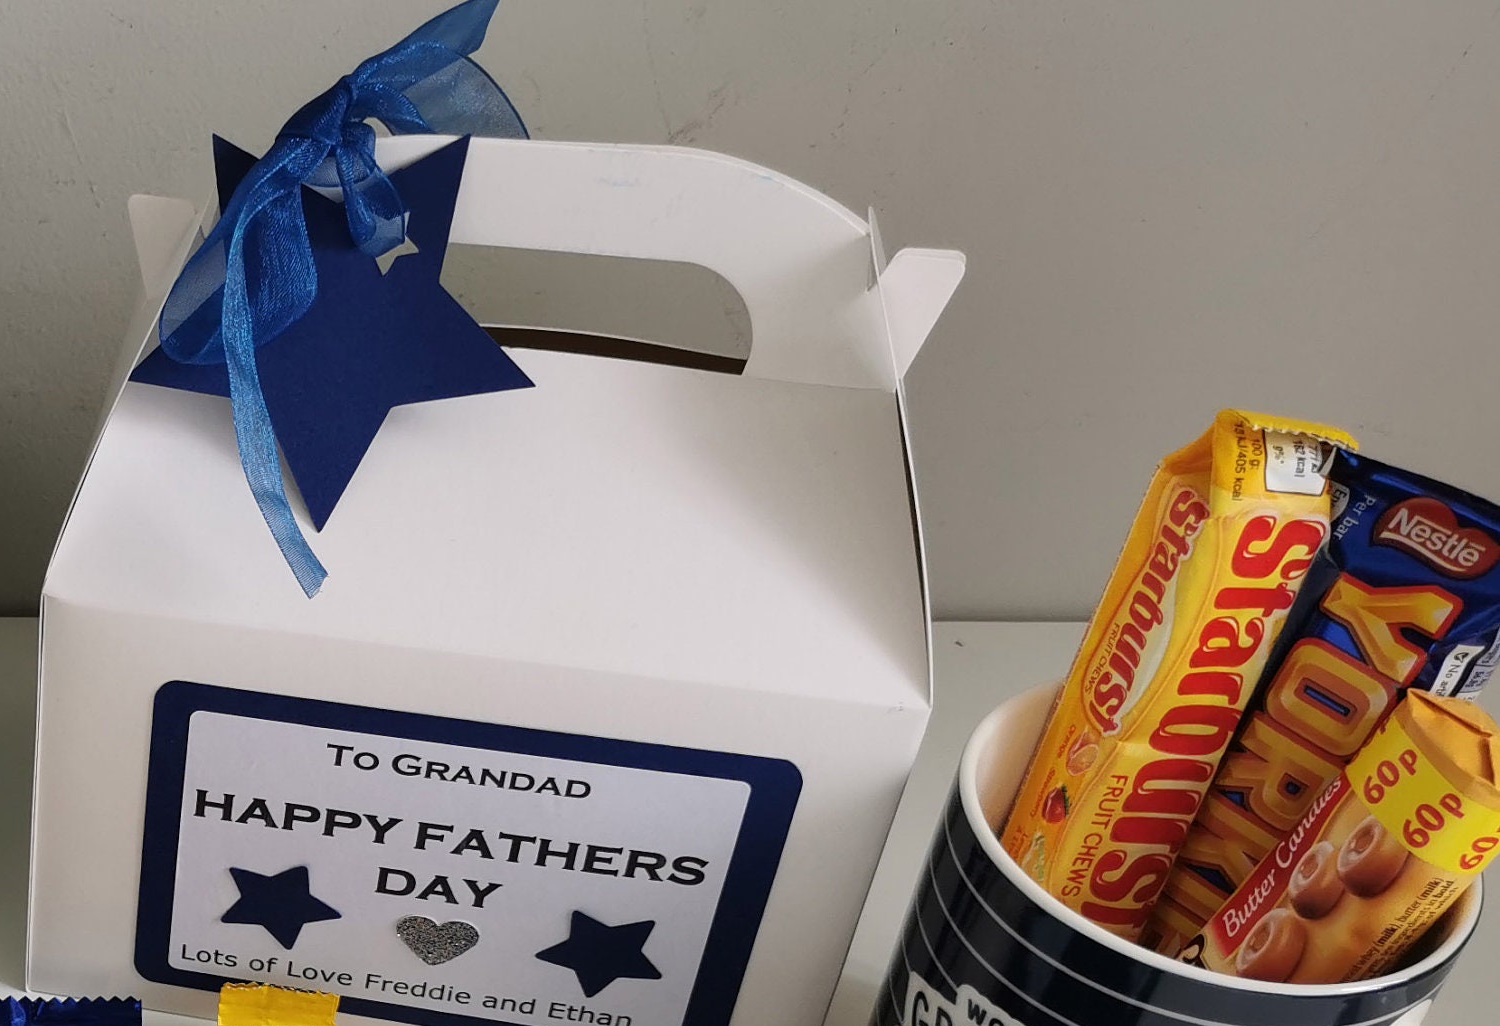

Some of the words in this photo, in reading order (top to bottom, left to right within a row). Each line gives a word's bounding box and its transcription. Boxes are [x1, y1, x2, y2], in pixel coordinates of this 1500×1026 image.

[1232, 477, 1246, 501] kcal
[1089, 490, 1210, 733] Starburst
[1101, 622, 1120, 659] FRUIT
[1084, 656, 1108, 695] CHEWS
[1080, 514, 1327, 928] Starburst
[1091, 775, 1128, 829] FRUIT
[1363, 749, 1418, 804] 60p
[194, 789, 405, 845] HAPPY
[413, 821, 710, 887] FATHERS
[1403, 793, 1464, 848] 60p
[1460, 826, 1500, 870] 60
[374, 866, 504, 909] DAY
[1061, 833, 1103, 898] CHEWS
[1222, 869, 1276, 938] Butter
[181, 943, 238, 971] Lots
[248, 950, 279, 973] of
[287, 960, 353, 987] Love
[365, 972, 472, 1006] Freddie
[482, 990, 537, 1016] and
